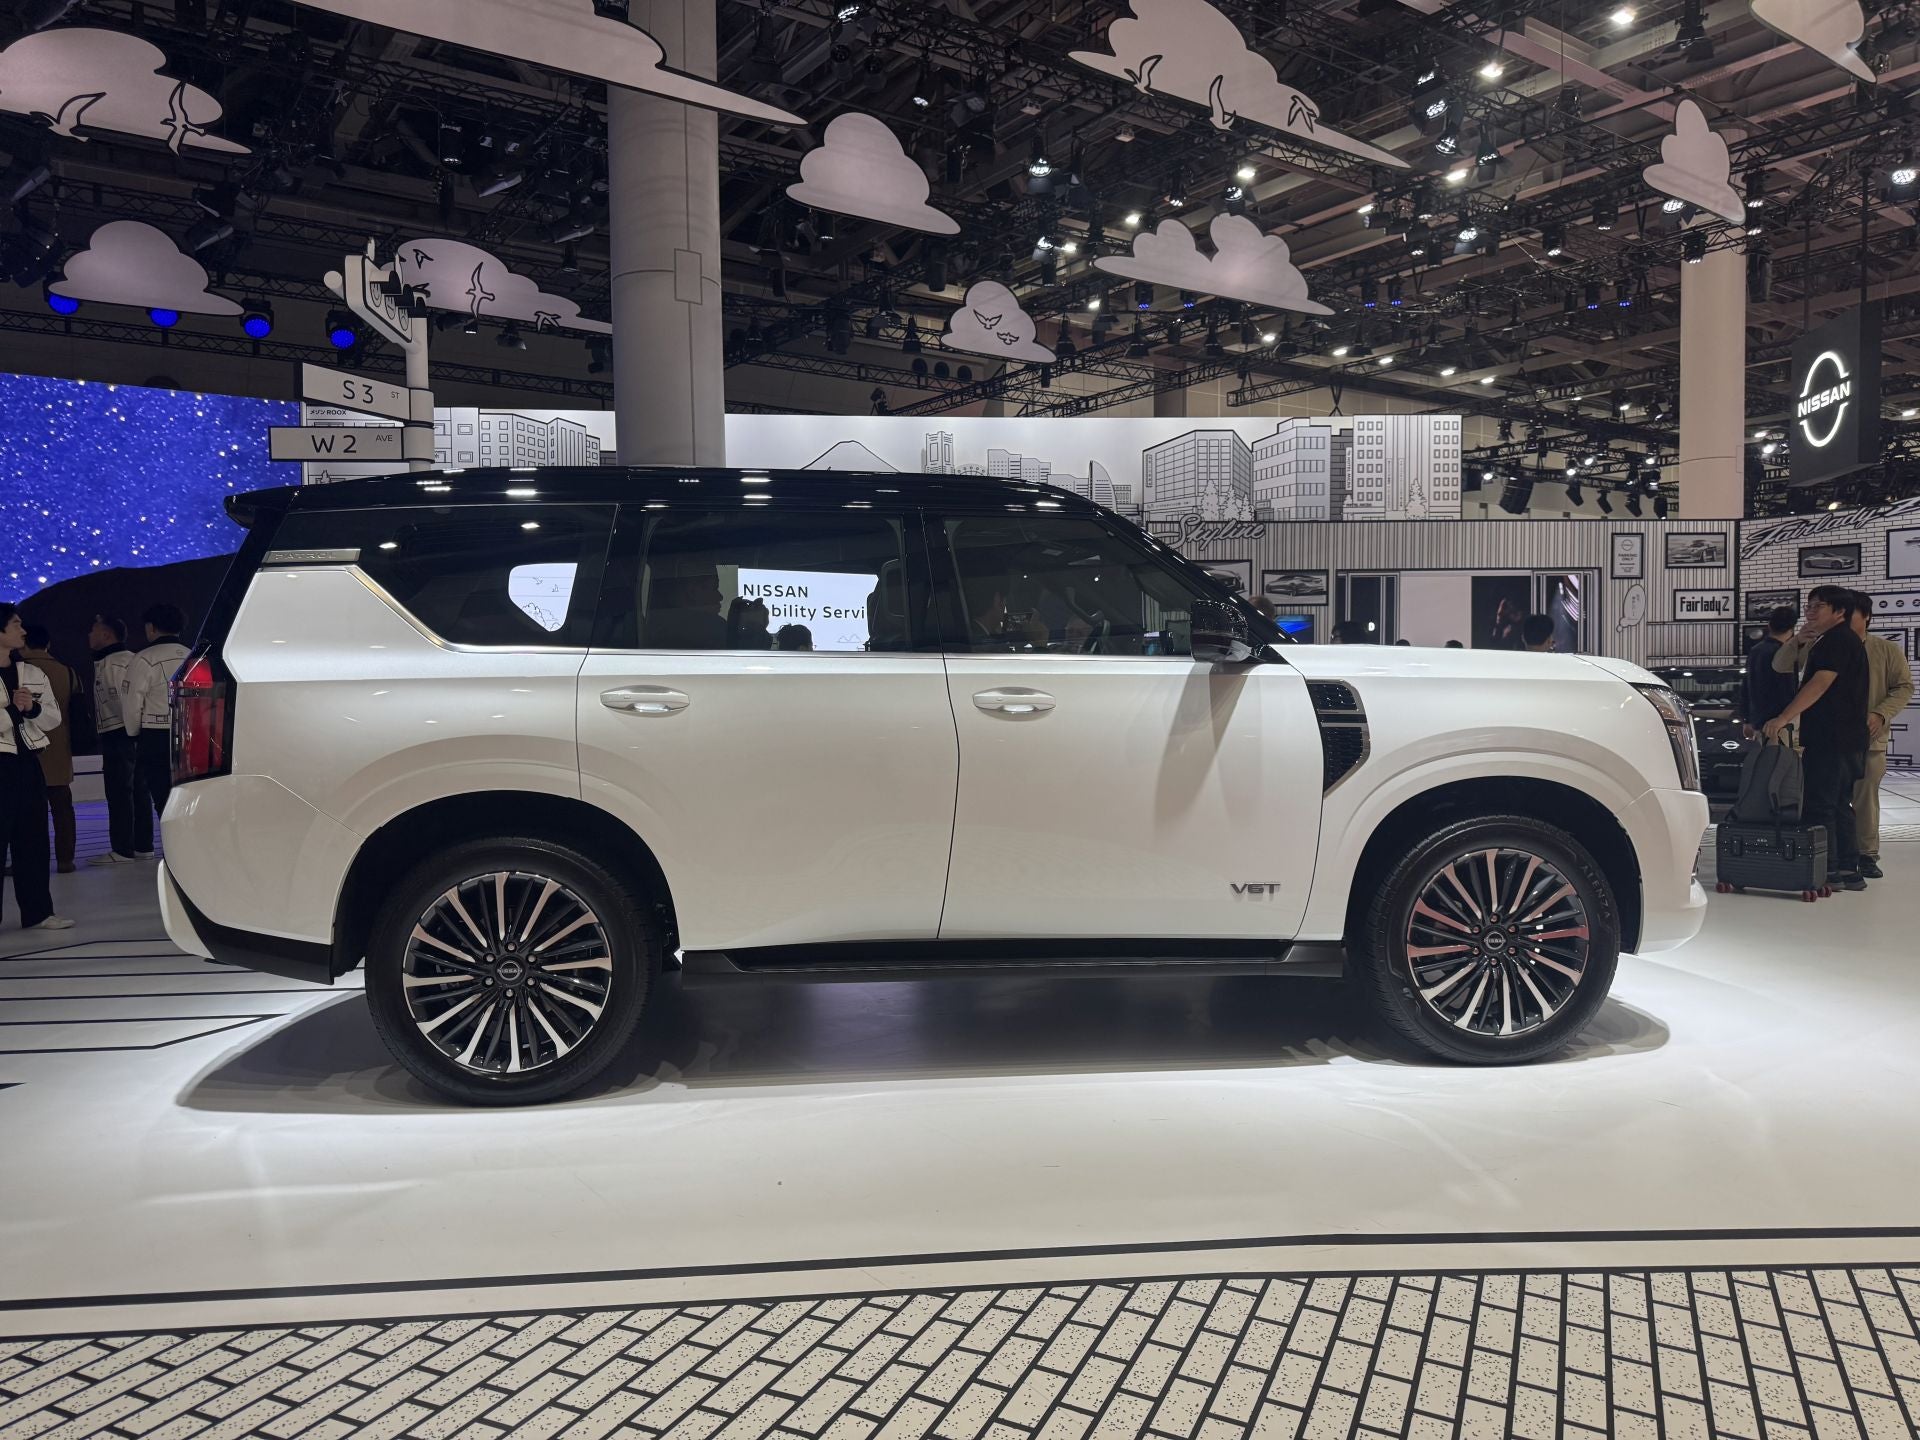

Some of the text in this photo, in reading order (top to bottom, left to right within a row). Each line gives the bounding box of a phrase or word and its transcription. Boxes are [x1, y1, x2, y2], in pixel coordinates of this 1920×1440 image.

[391, 391, 400, 399] ST
[1797, 381, 1850, 417] NISSAN
[375, 434, 393, 442] AVE
[1153, 512, 1265, 551] Skyline
[1739, 506, 1881, 559] Fairlady
[743, 584, 808, 598] NISSAN
[771, 604, 865, 621] bility Servi
[1680, 596, 1730, 616] Fairlady Z
[1230, 882, 1281, 894] V6T
